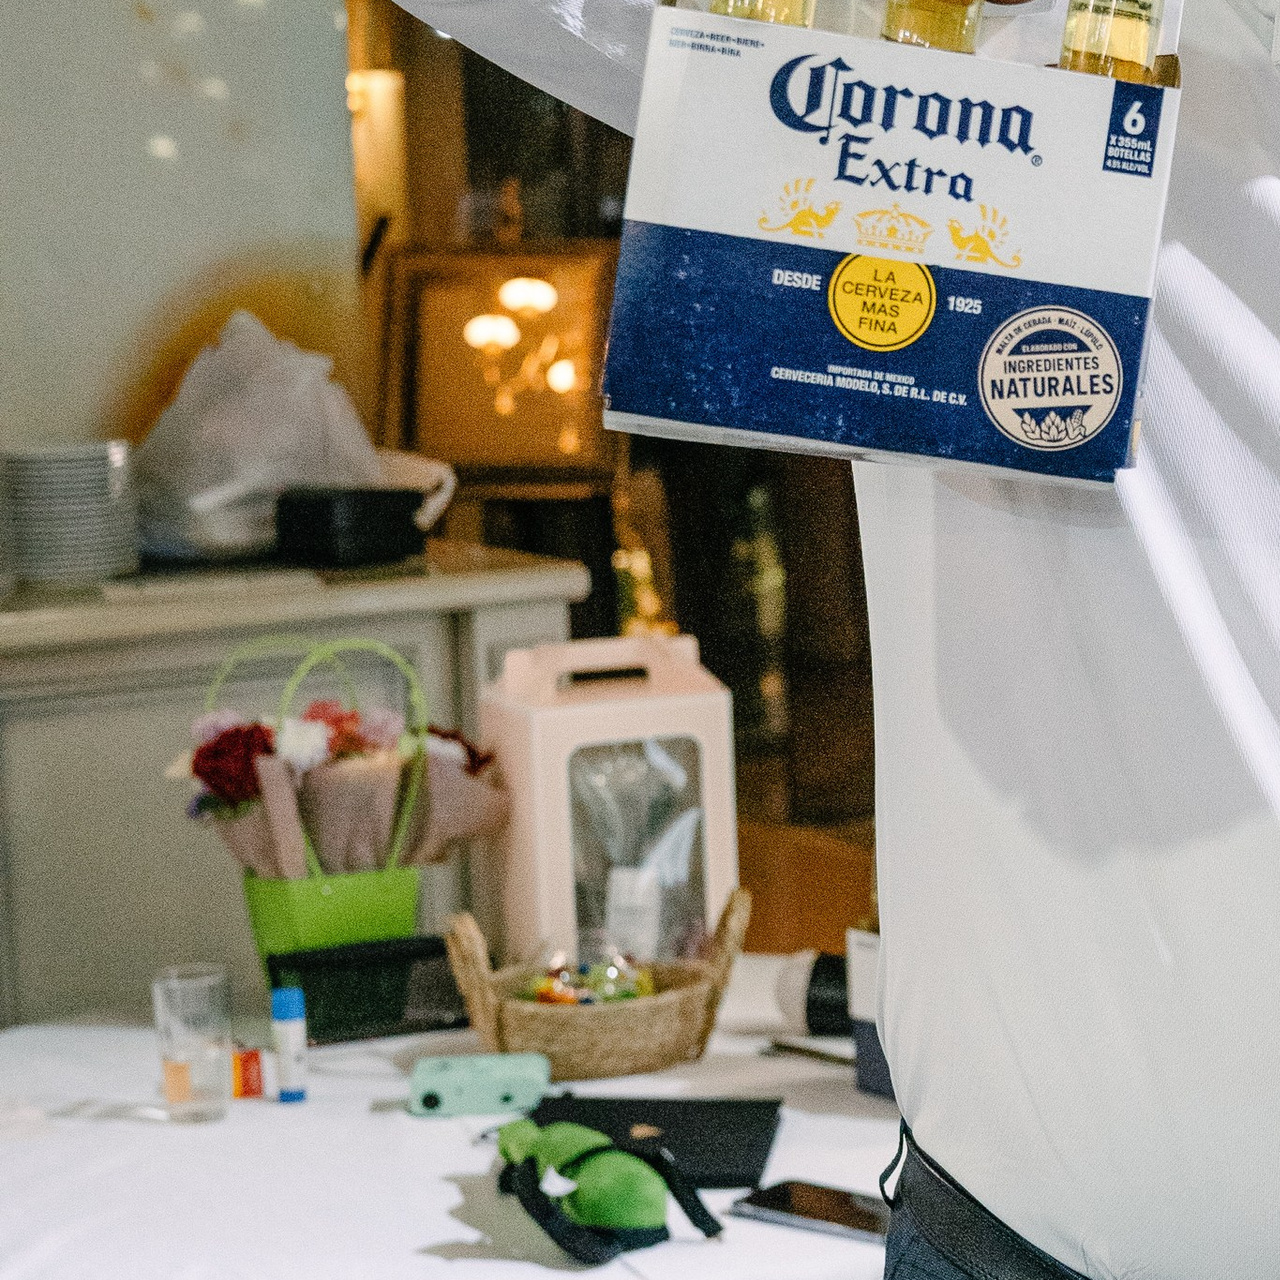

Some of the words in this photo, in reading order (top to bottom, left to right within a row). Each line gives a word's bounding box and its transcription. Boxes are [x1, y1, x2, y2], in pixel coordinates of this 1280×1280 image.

[769, 54, 1034, 155] Corona
[1123, 100, 1146, 136] 6
[1118, 135, 1152, 151] 355mL
[1107, 145, 1152, 163] BOTELLAS
[834, 132, 974, 202] Extra
[873, 268, 896, 284] LA
[772, 268, 822, 291] DESDE
[947, 295, 983, 315] 1925
[842, 280, 924, 305] CERVEZA
[861, 300, 900, 318] MAS
[858, 317, 898, 334] FINA
[996, 332, 1014, 355] MALTA
[1013, 325, 1024, 336] DE
[1023, 316, 1052, 329] CEBADA
[1022, 343, 1063, 353] ELABORADO
[827, 364, 872, 379] IMPORTADA
[873, 369, 884, 380] DE
[1003, 356, 1099, 374] INGREDIENTES
[770, 366, 834, 386] CERVECERIA
[835, 376, 880, 395] MODELO,
[881, 382, 893, 395] S.
[893, 384, 908, 398] DE
[909, 387, 930, 401] R.L.
[932, 389, 947, 403] DE
[948, 391, 968, 406] C.V.
[990, 373, 1114, 400] NATURALES
